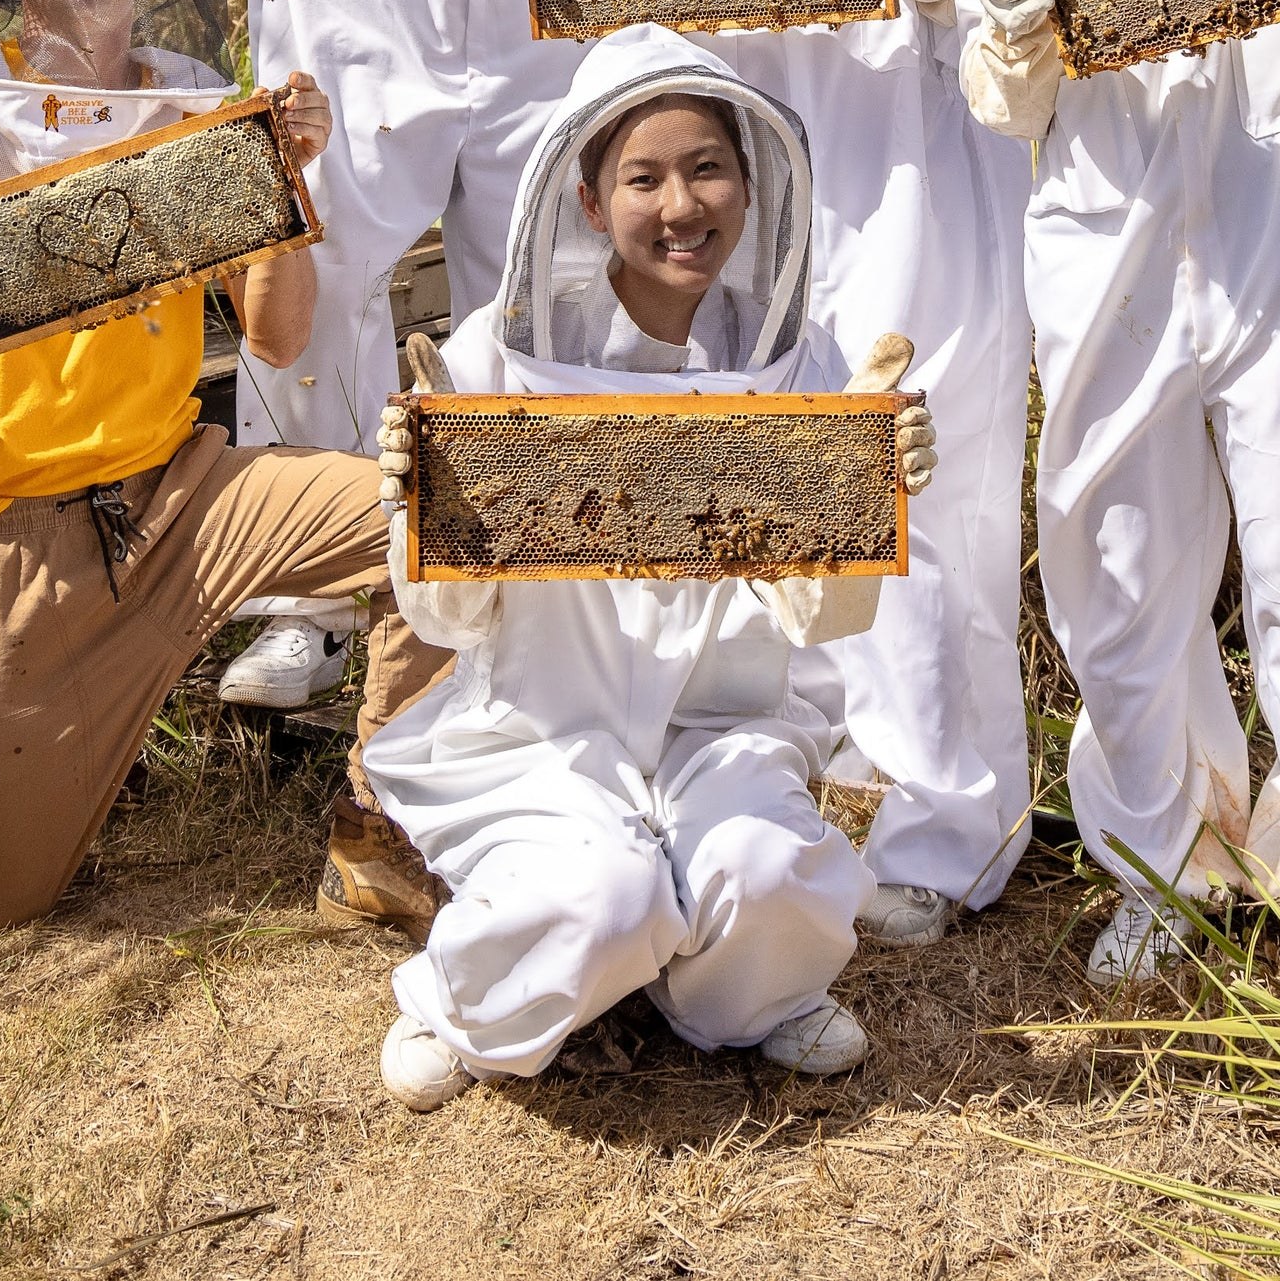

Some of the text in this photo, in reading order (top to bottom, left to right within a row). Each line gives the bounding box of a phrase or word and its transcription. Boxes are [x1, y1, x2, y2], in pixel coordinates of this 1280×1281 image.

[60, 99, 104, 107] MASSIVE
[67, 107, 87, 116] BEE
[60, 116, 93, 125] STORE
